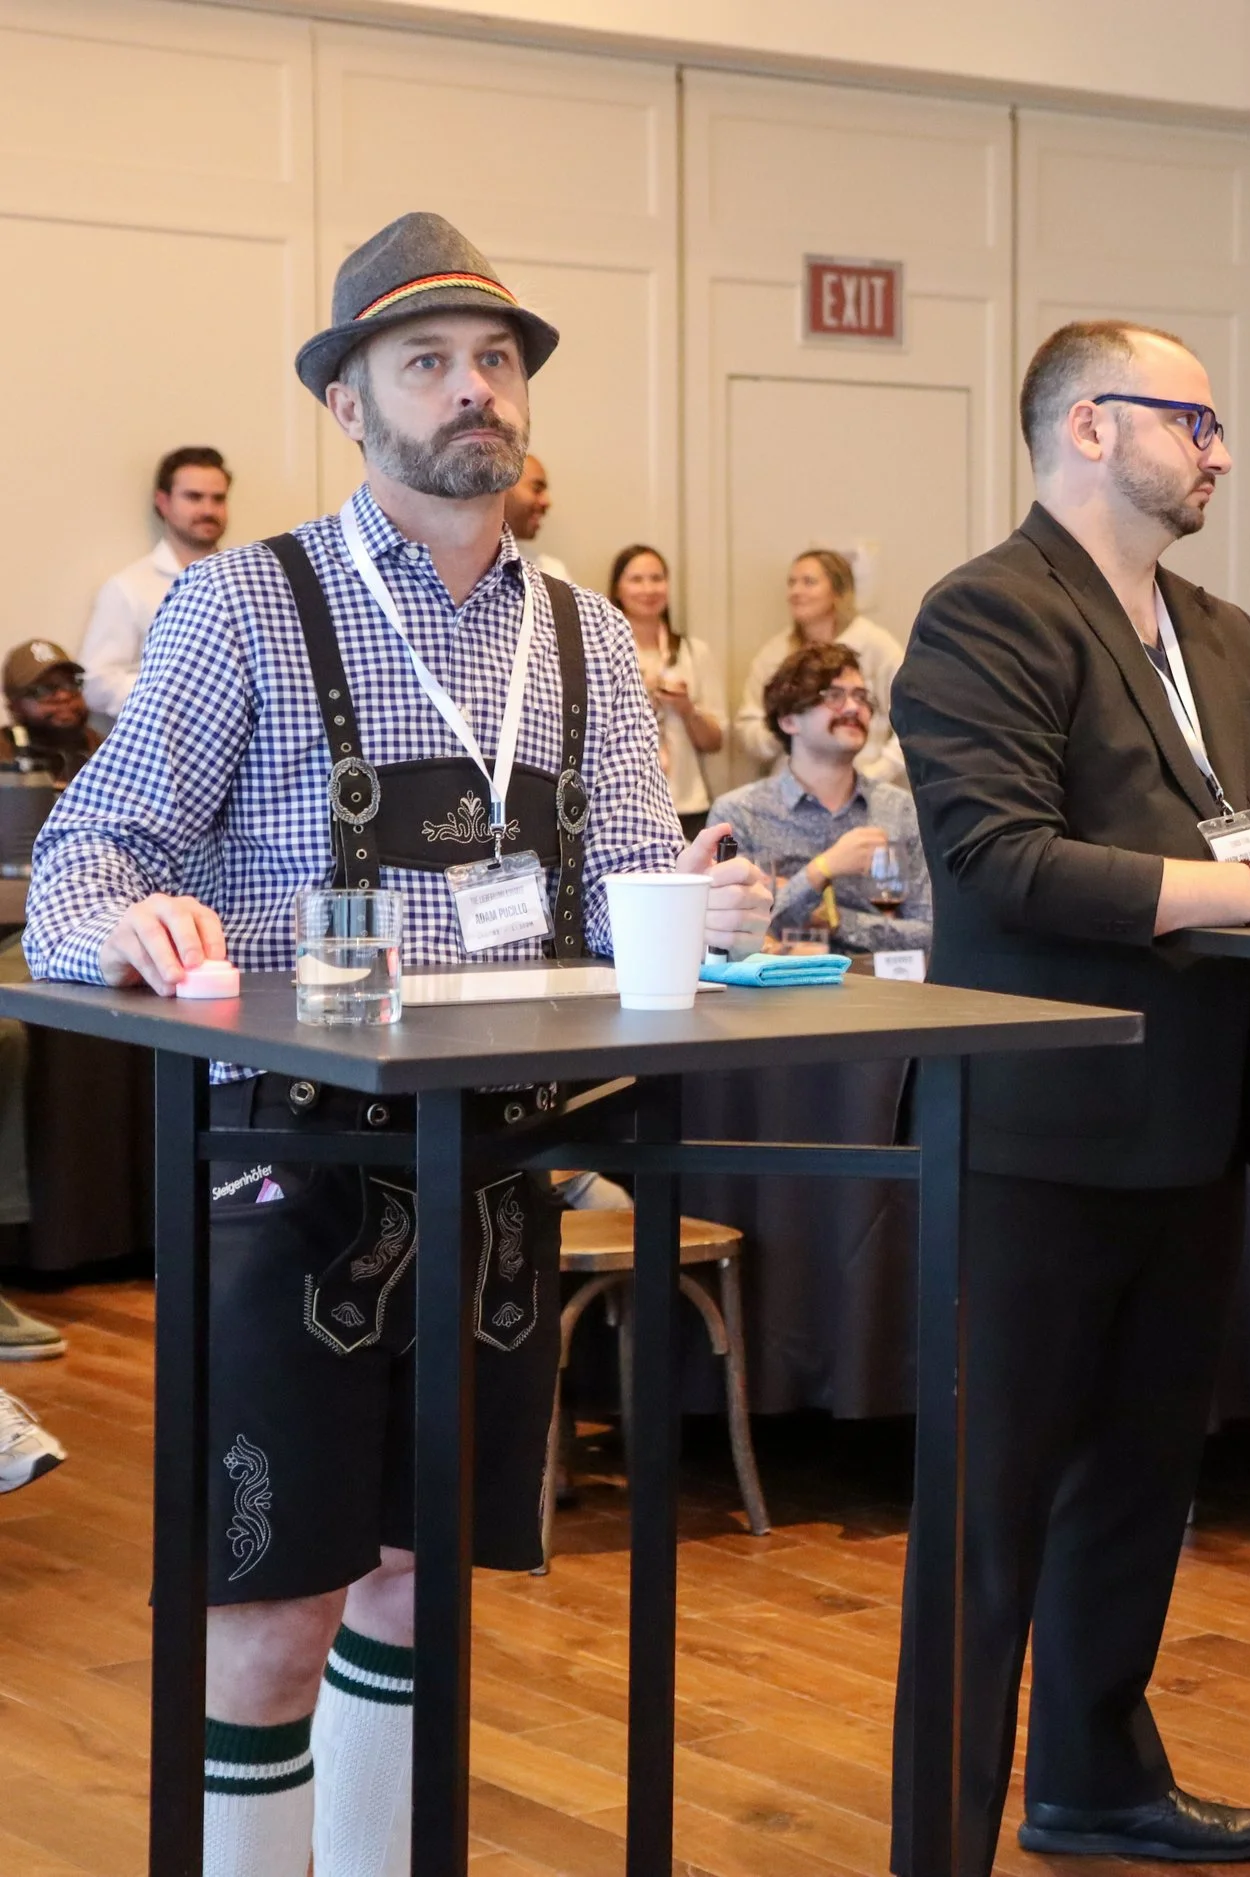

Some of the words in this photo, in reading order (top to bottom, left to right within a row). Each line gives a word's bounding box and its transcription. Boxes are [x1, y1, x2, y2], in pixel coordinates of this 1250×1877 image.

[822, 273, 886, 329] EXIT
[475, 909, 498, 925] ADAM
[498, 902, 528, 921] PUCILLO
